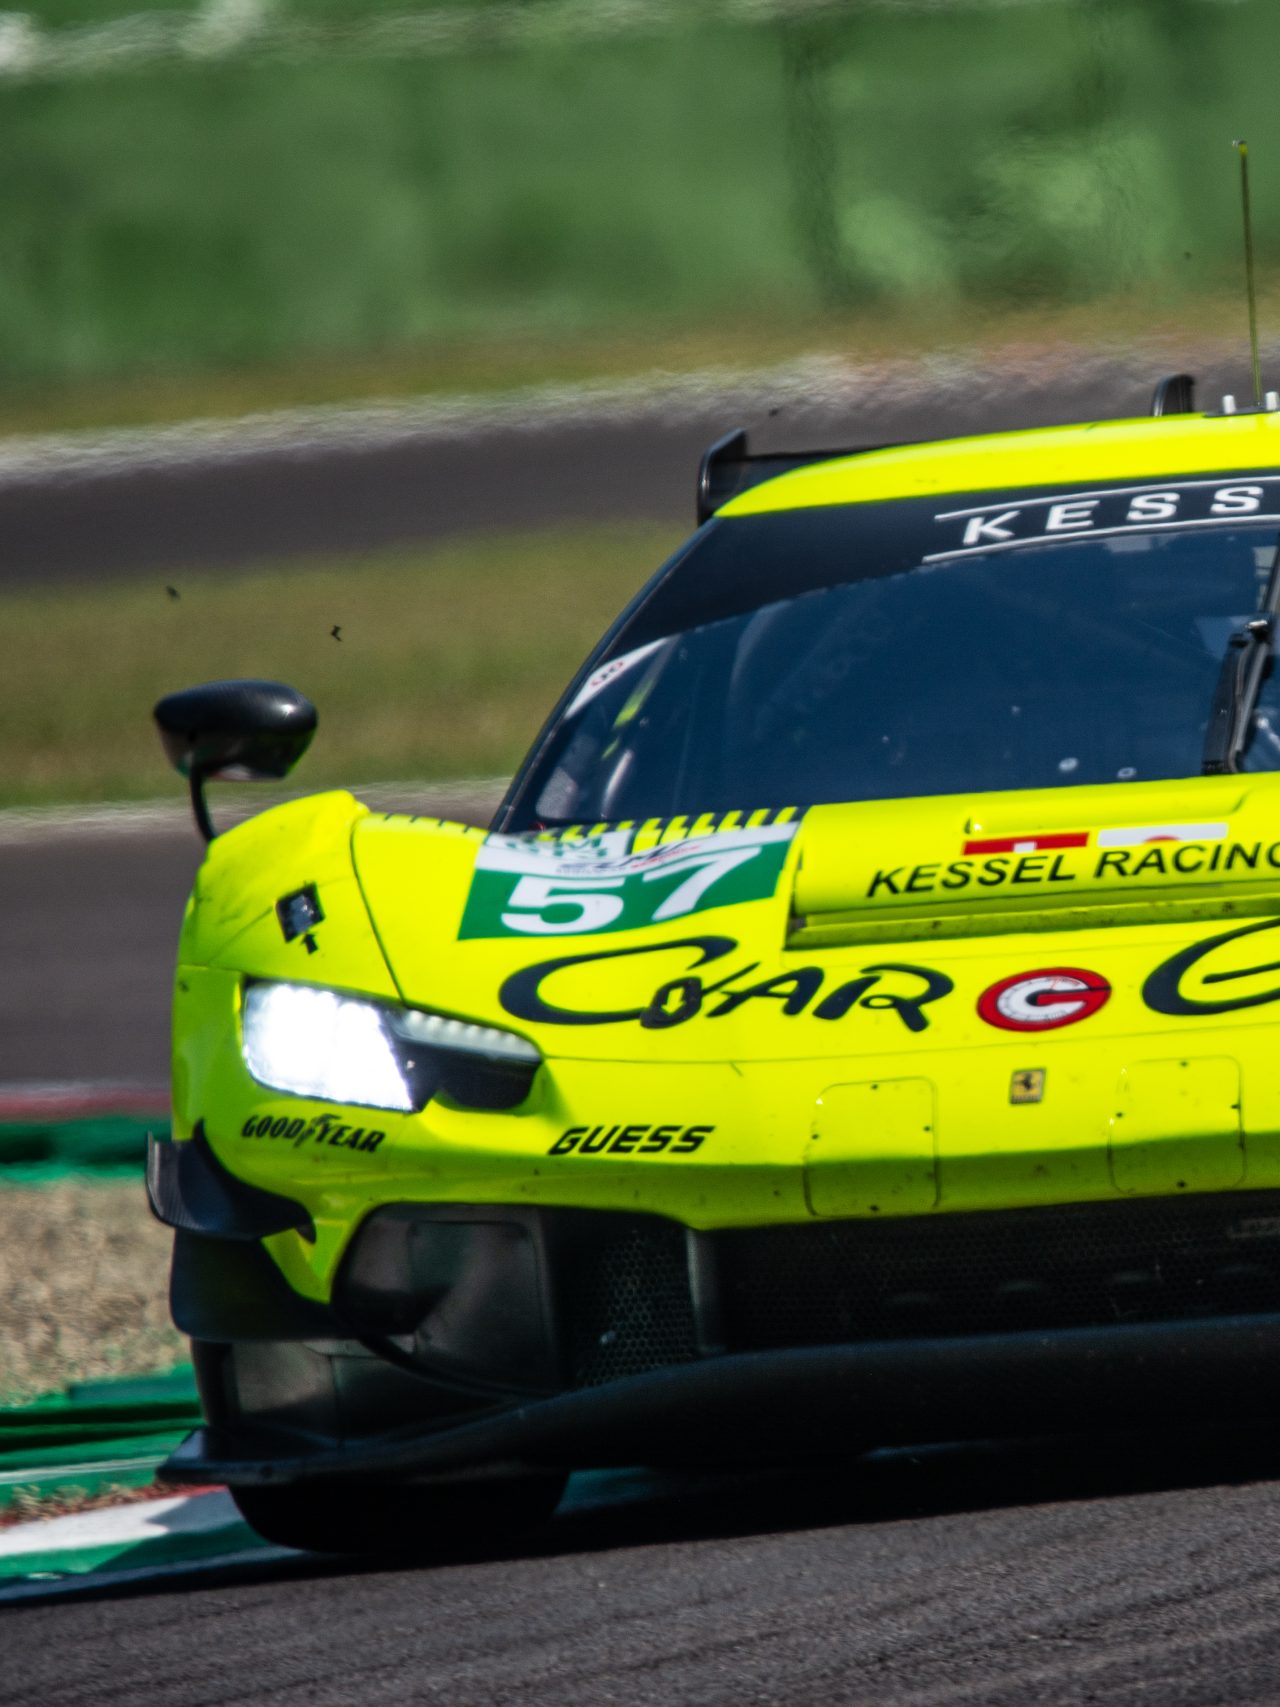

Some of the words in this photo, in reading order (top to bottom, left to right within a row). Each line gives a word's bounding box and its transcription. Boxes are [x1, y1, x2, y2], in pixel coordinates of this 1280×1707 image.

[500, 846, 762, 934] 57
[866, 855, 1076, 897] KESSEL
[497, 935, 955, 1032] CAR
[240, 1113, 387, 1154] GOODYEAR
[547, 1125, 715, 1156] GUESS
